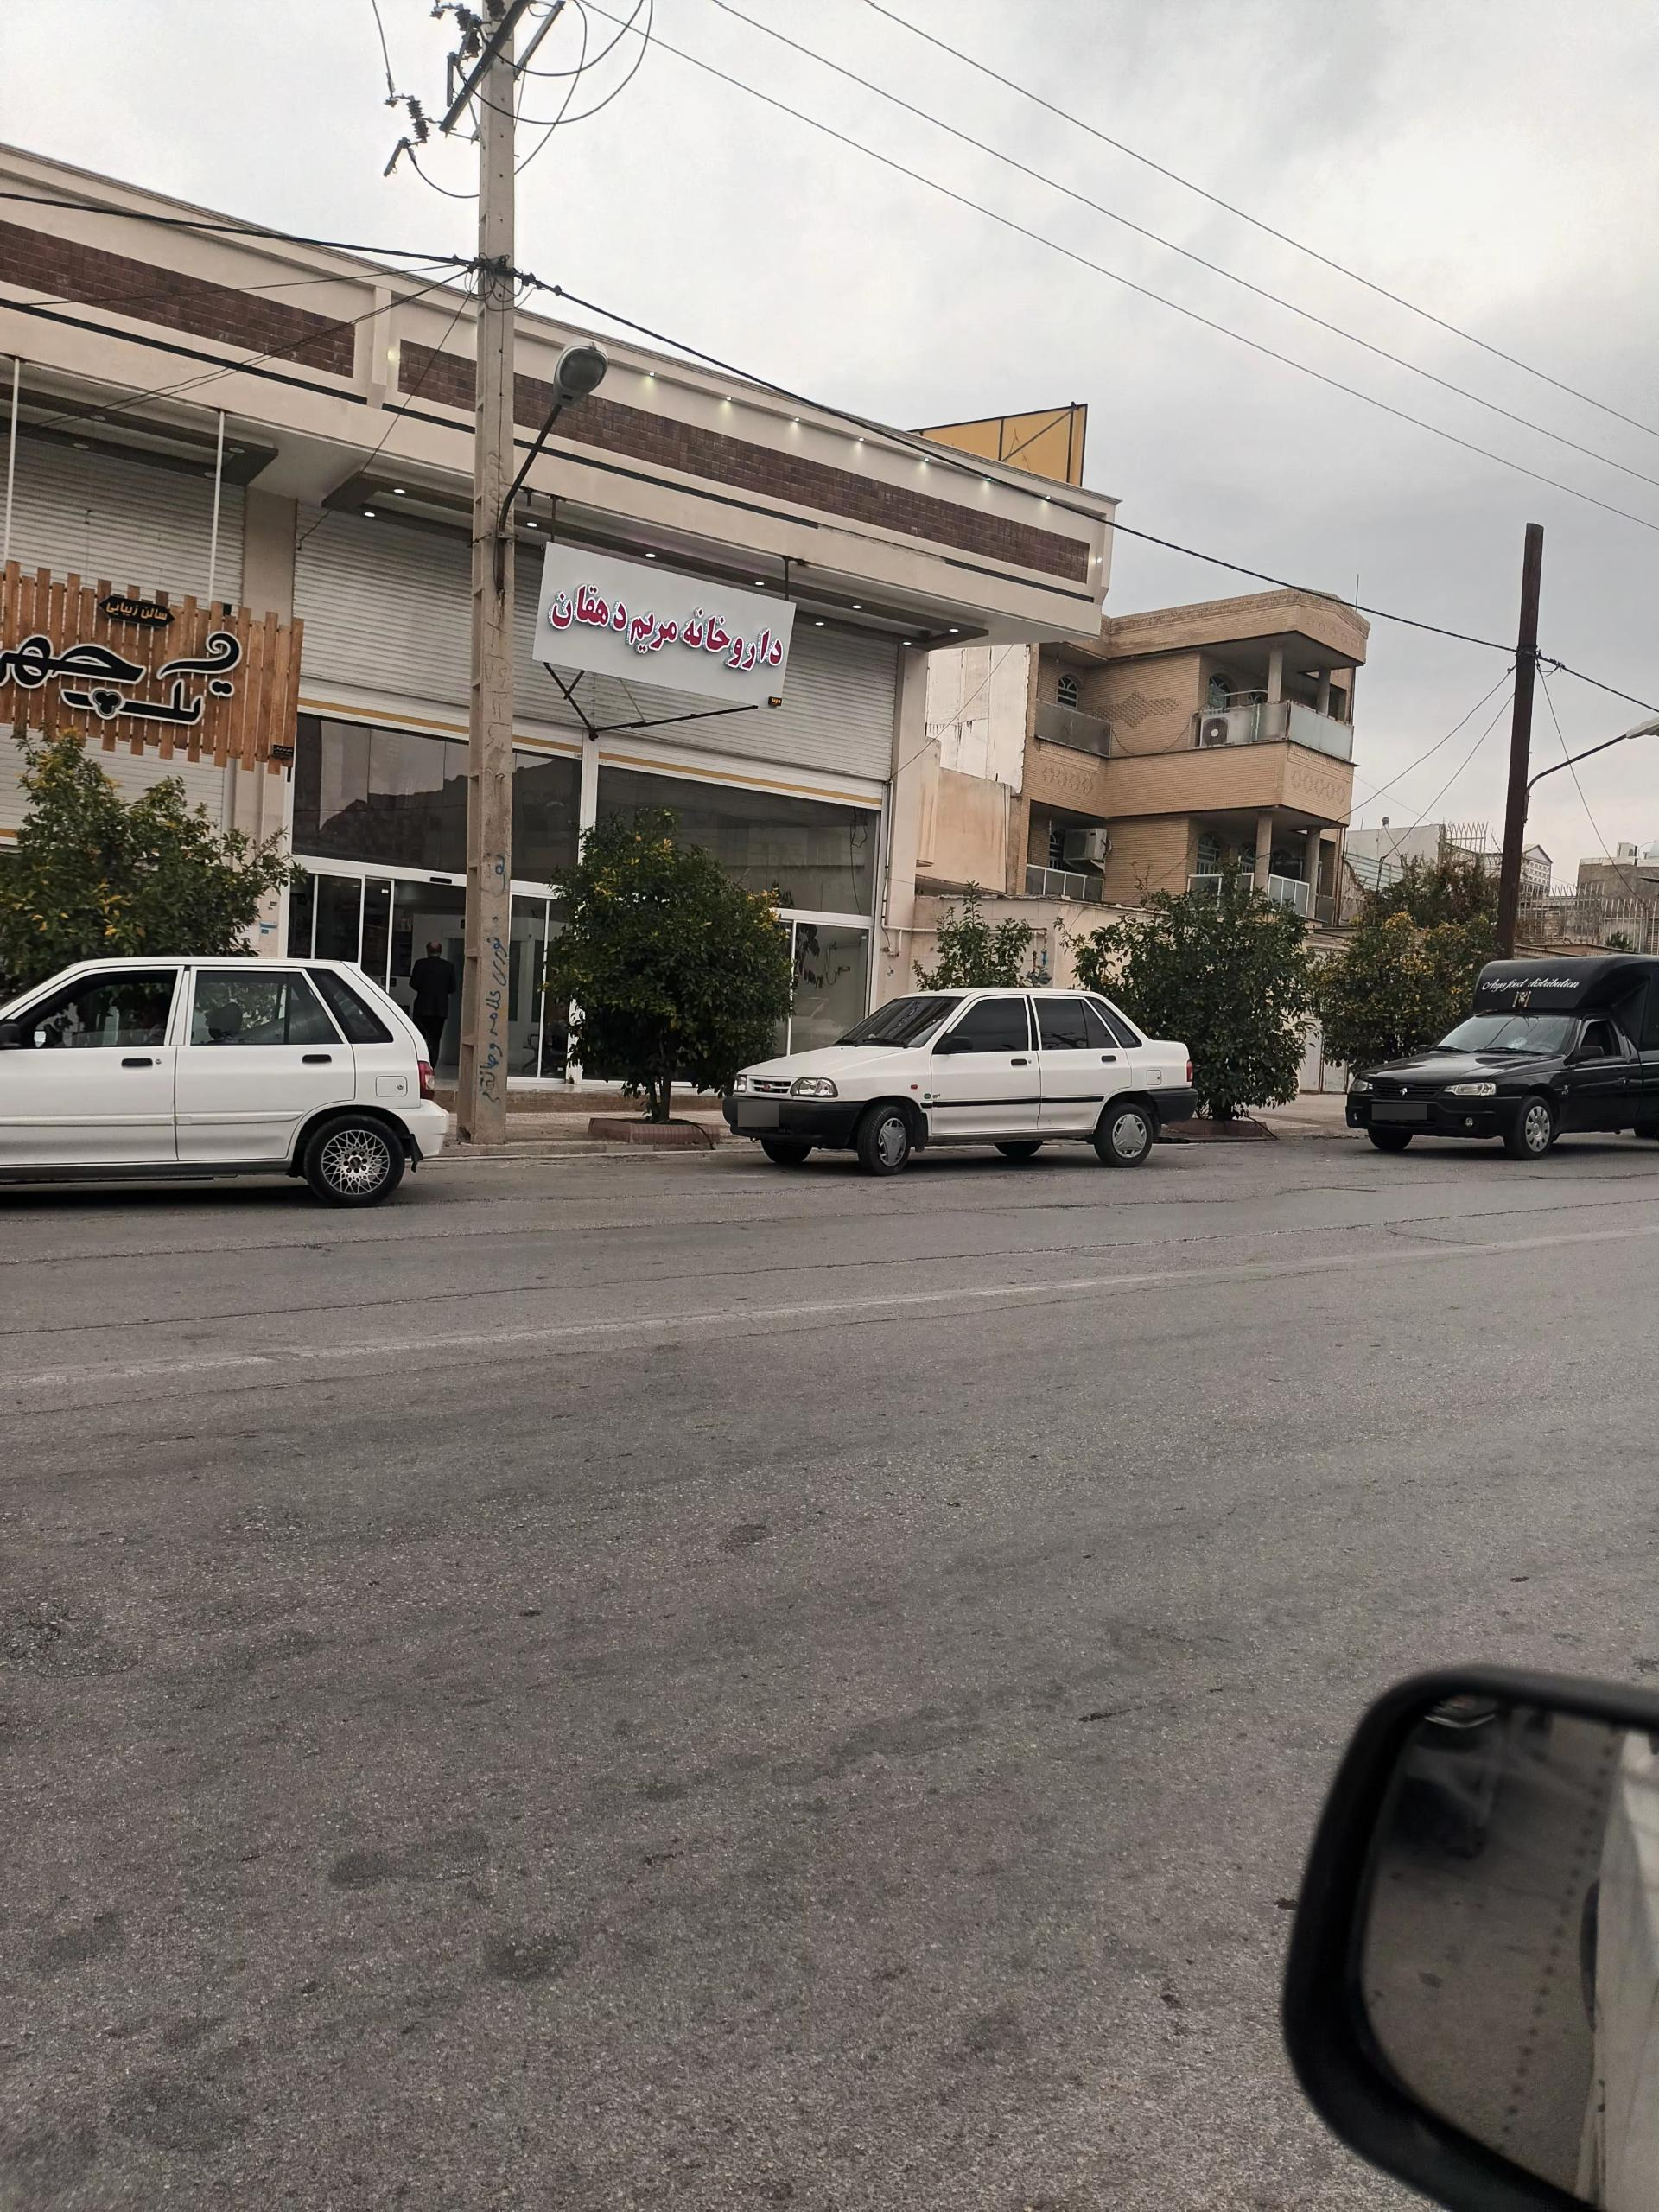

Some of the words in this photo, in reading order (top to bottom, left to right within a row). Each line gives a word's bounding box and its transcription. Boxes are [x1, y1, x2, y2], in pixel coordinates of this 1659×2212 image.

[105, 602, 138, 615] زیبایی
[141, 607, 168, 620] سالن
[549, 584, 627, 631] دهقان
[627, 613, 677, 653] مریم
[682, 608, 783, 671] داروخانه
[1528, 977, 1580, 988] distribution
